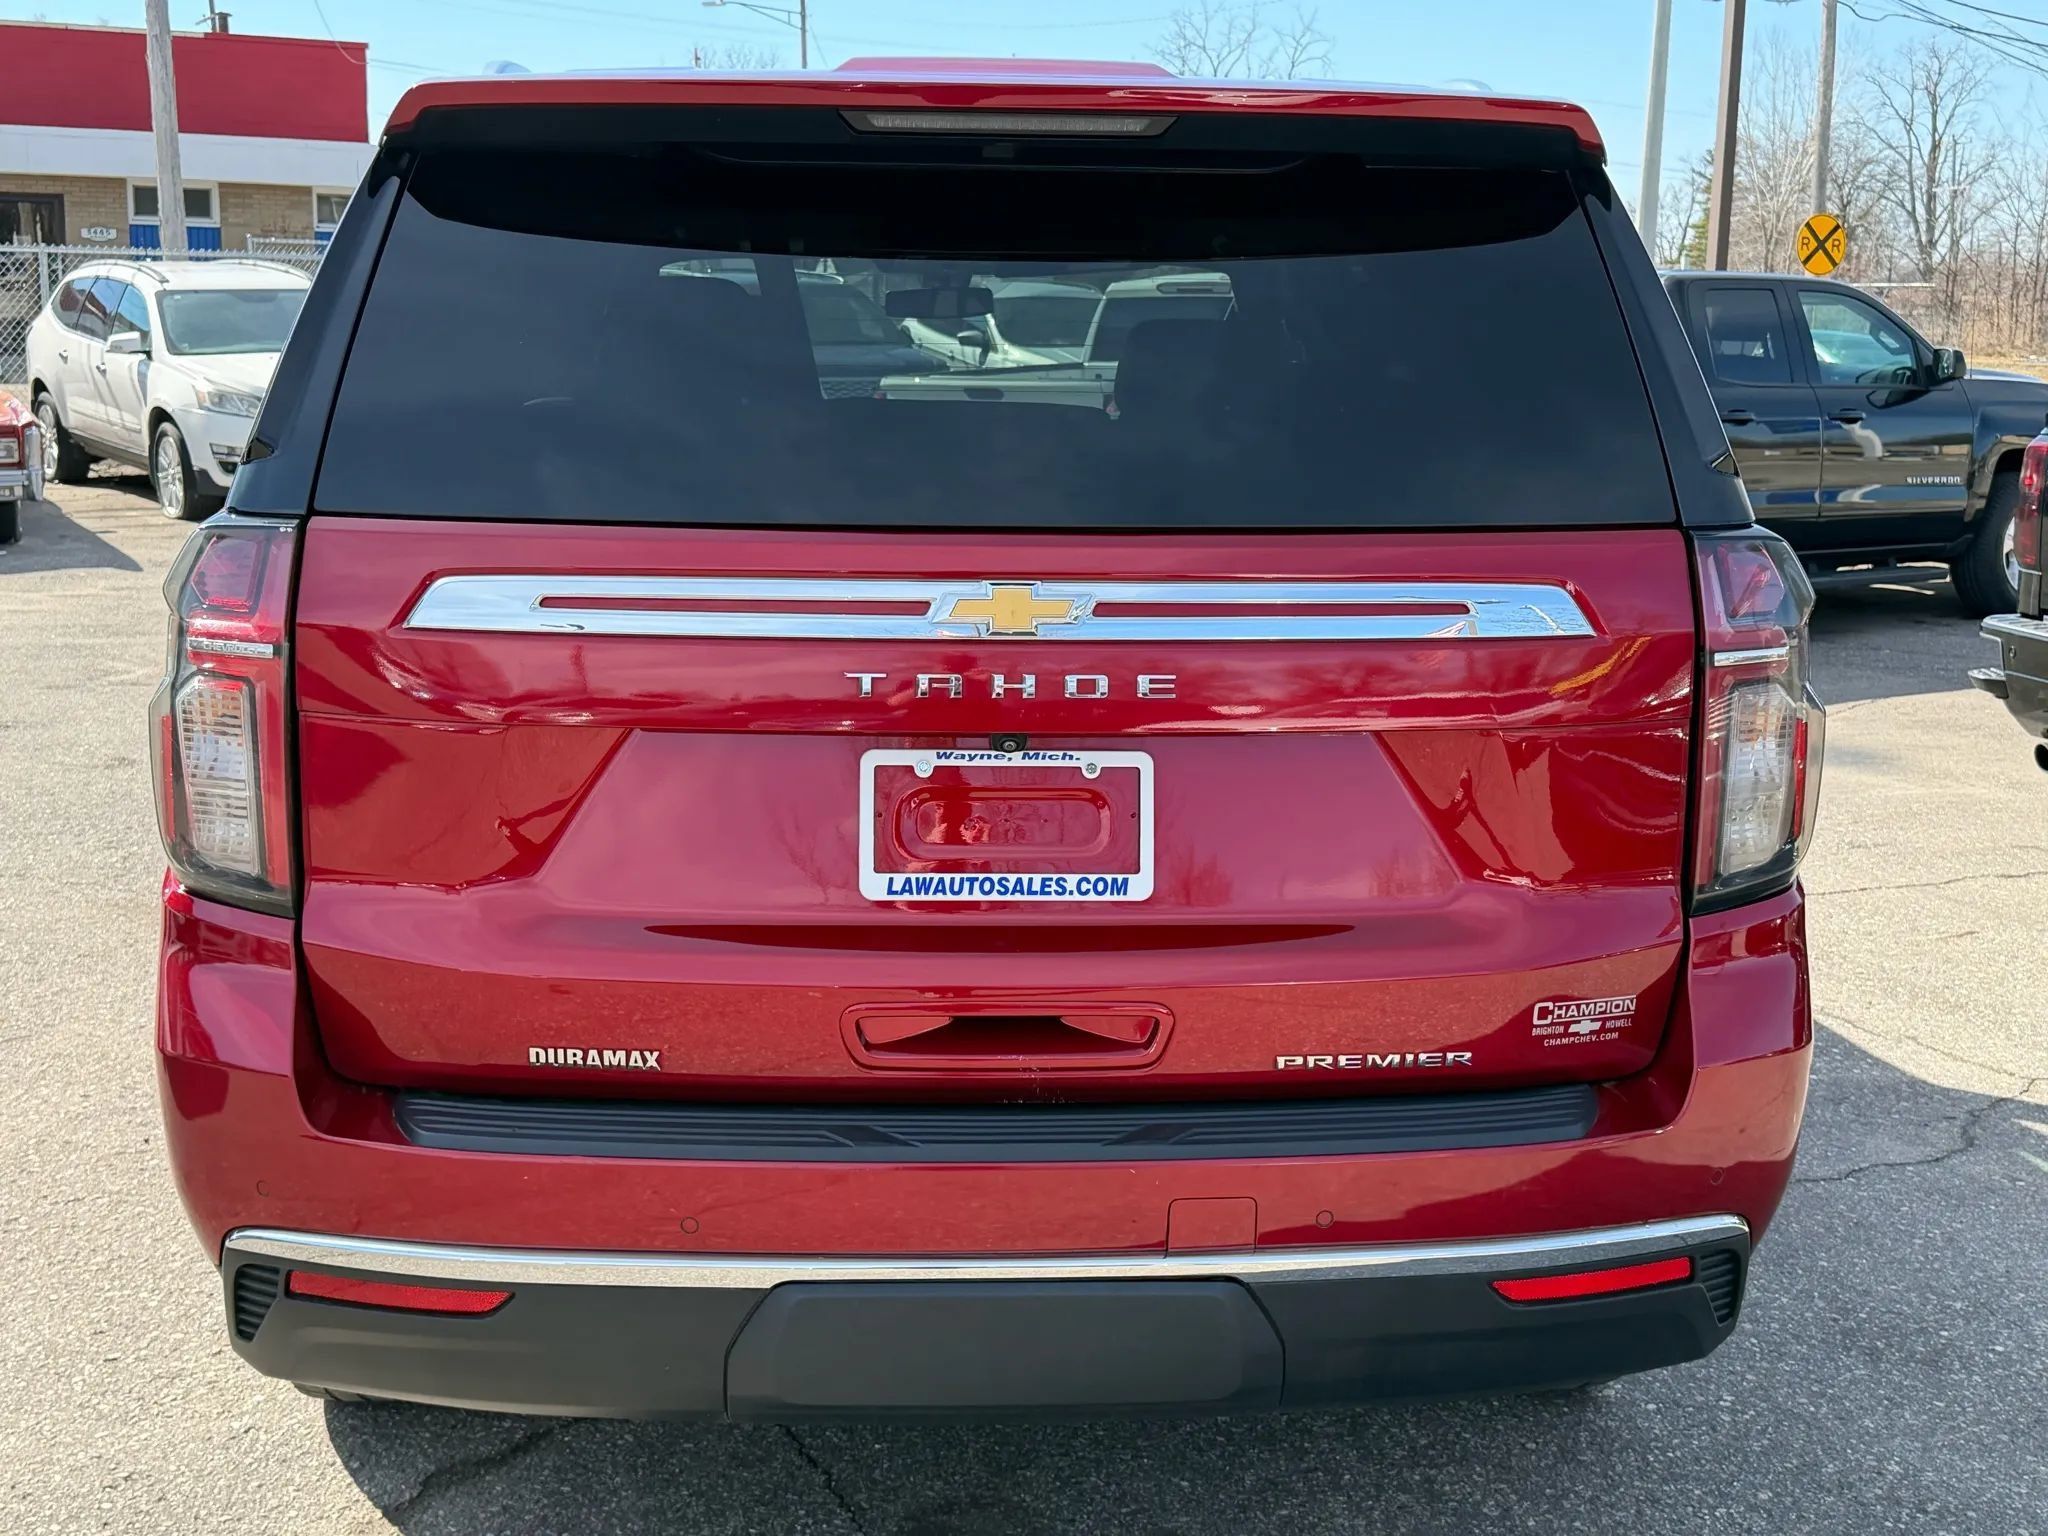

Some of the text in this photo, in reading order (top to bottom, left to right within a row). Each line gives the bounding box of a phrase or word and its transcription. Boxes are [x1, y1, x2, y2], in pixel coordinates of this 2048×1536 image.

[1801, 236, 1842, 254] R R
[1906, 476, 1961, 485] SILVERADO
[843, 672, 1177, 698] TAHOE
[936, 751, 1081, 762] Wayne, Mich.
[886, 876, 1129, 896] LAWAUTOSALES.COM
[1532, 998, 1637, 1025] CHAMPION
[1531, 1018, 1632, 1036] BRIGHTON HOWELL
[1543, 1031, 1619, 1047] CHAMPCHEV.COM
[528, 1047, 661, 1071] DURAMAX
[1275, 1051, 1473, 1070] PREMIER
